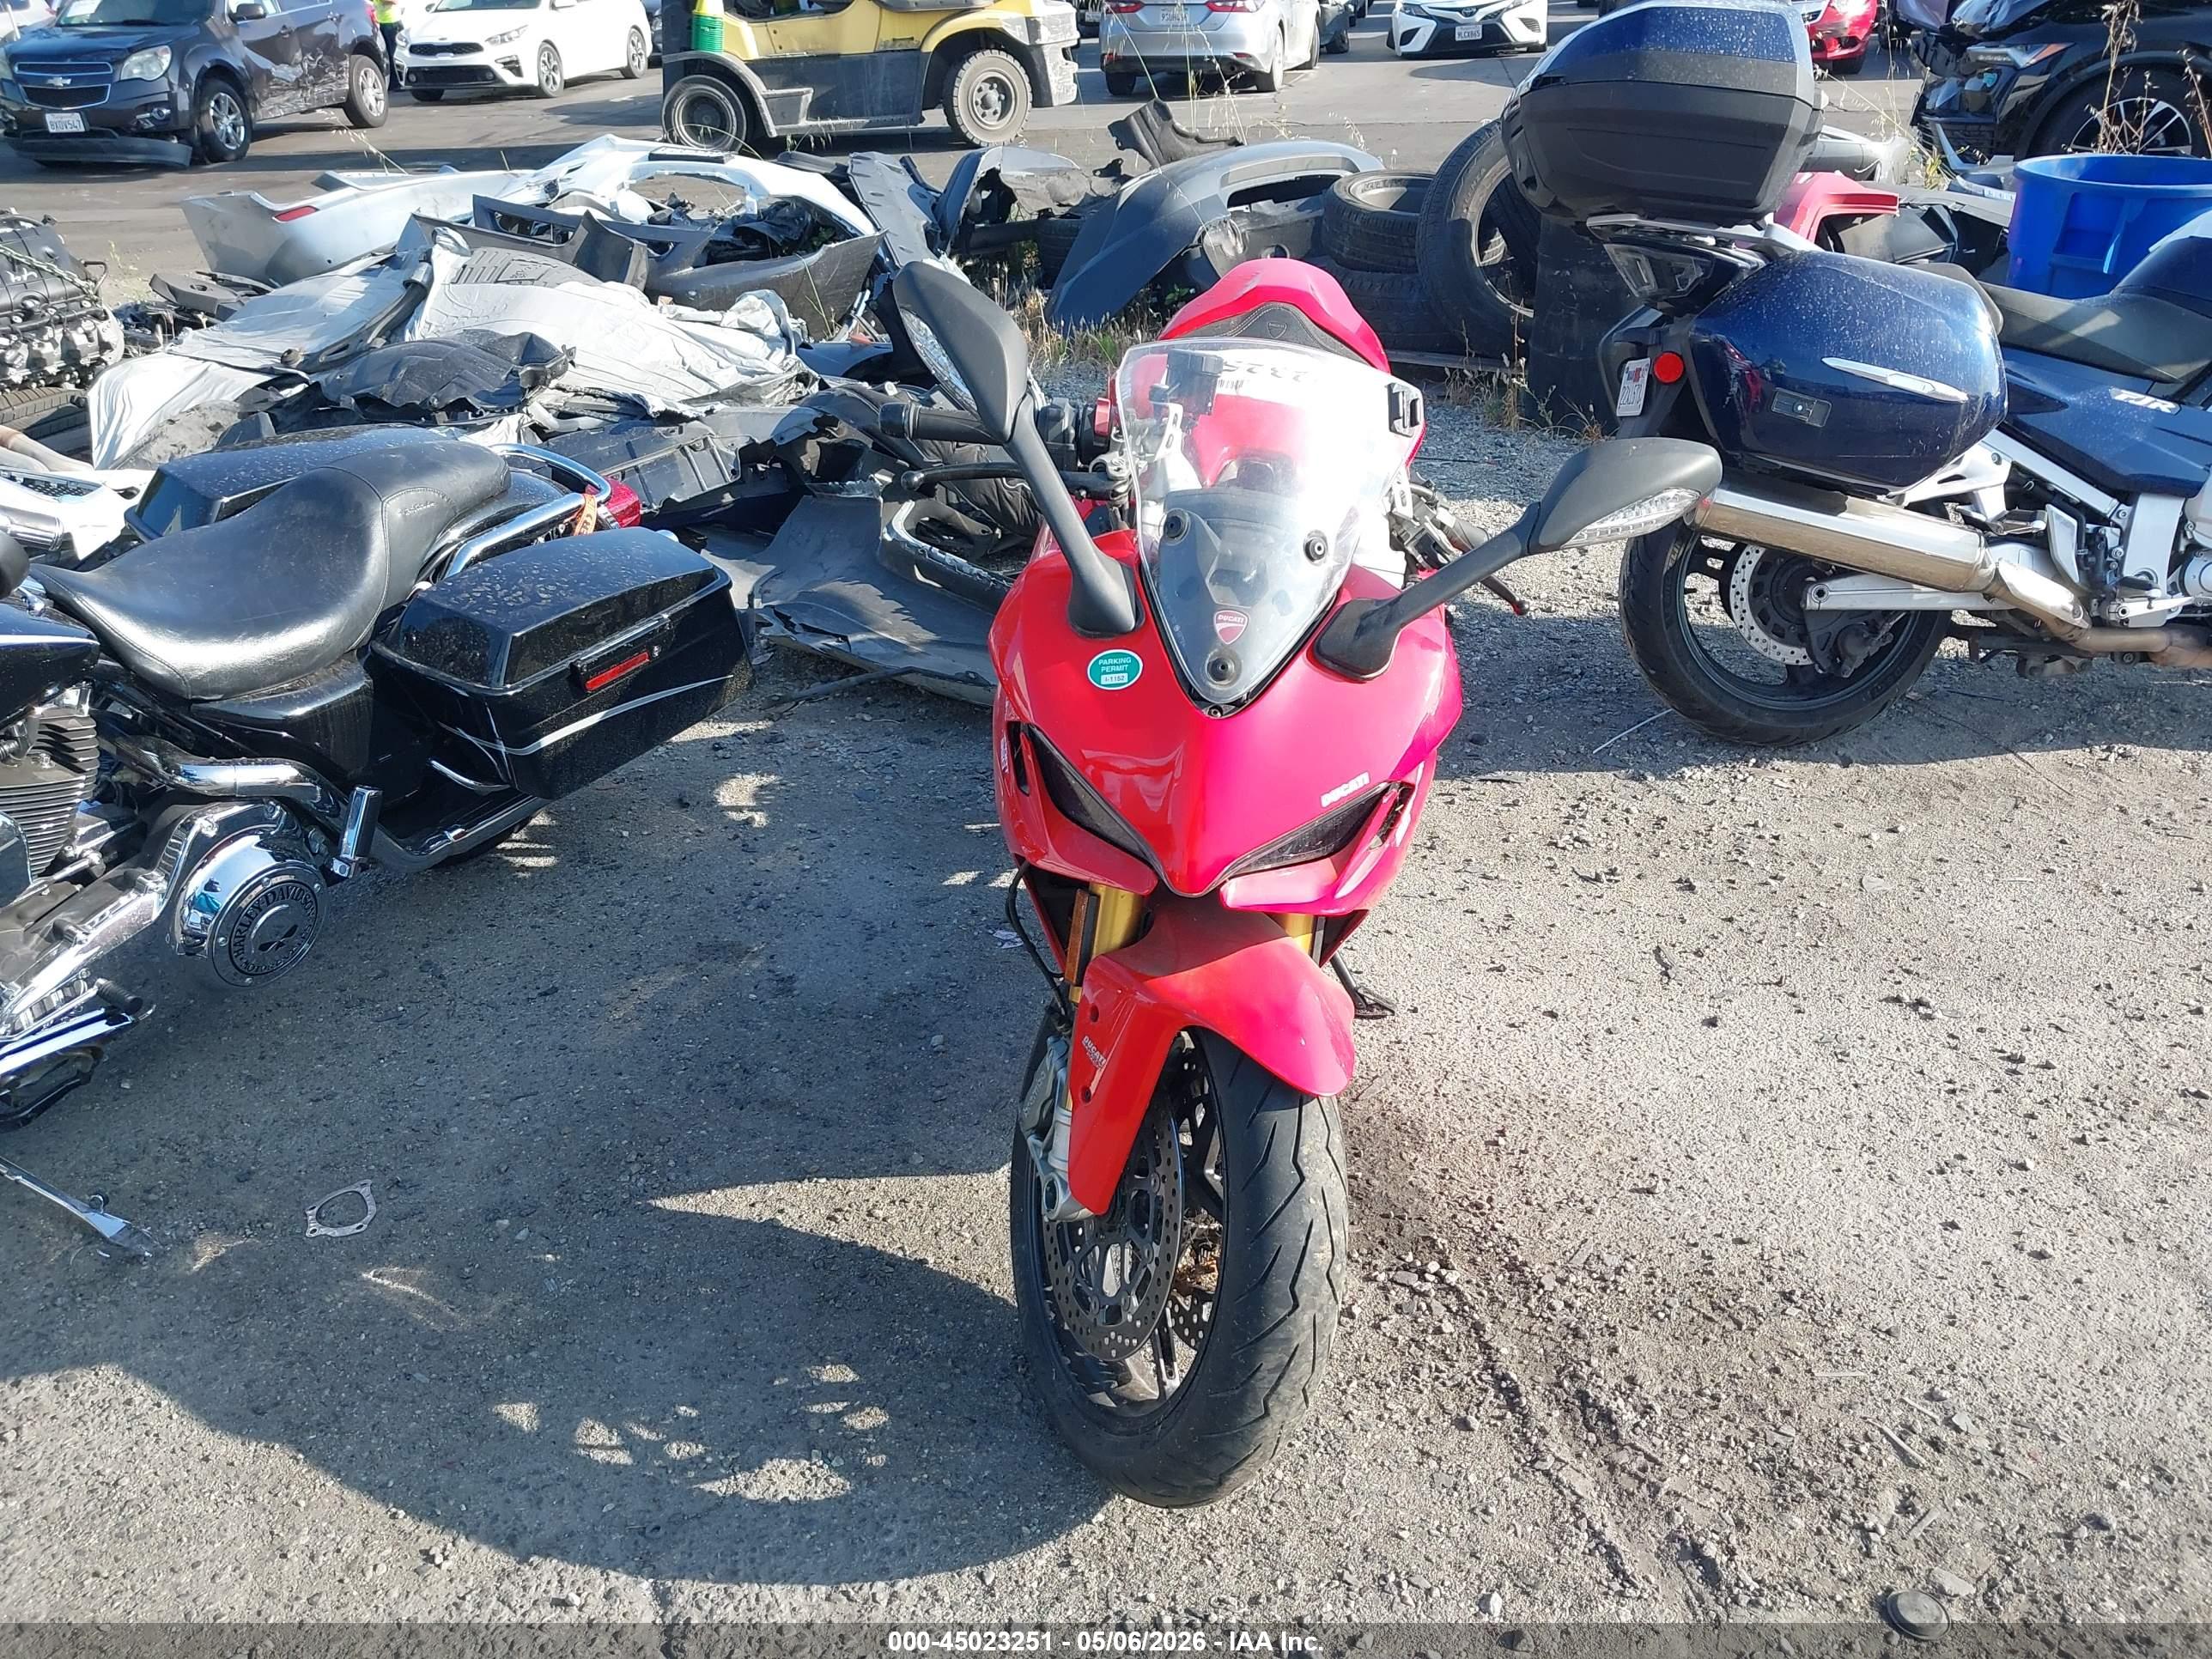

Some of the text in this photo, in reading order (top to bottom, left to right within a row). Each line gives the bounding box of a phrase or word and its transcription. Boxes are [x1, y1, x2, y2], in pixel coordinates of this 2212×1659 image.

[1218, 614, 1244, 623] DUCATI
[1098, 657, 1132, 665] PARKING
[1101, 665, 1128, 673] PERMIT
[1320, 771, 1370, 808] DUCATI
[233, 885, 316, 959] HARLEY-DAVIDSON
[1082, 1035, 1107, 1066] DUCATI
